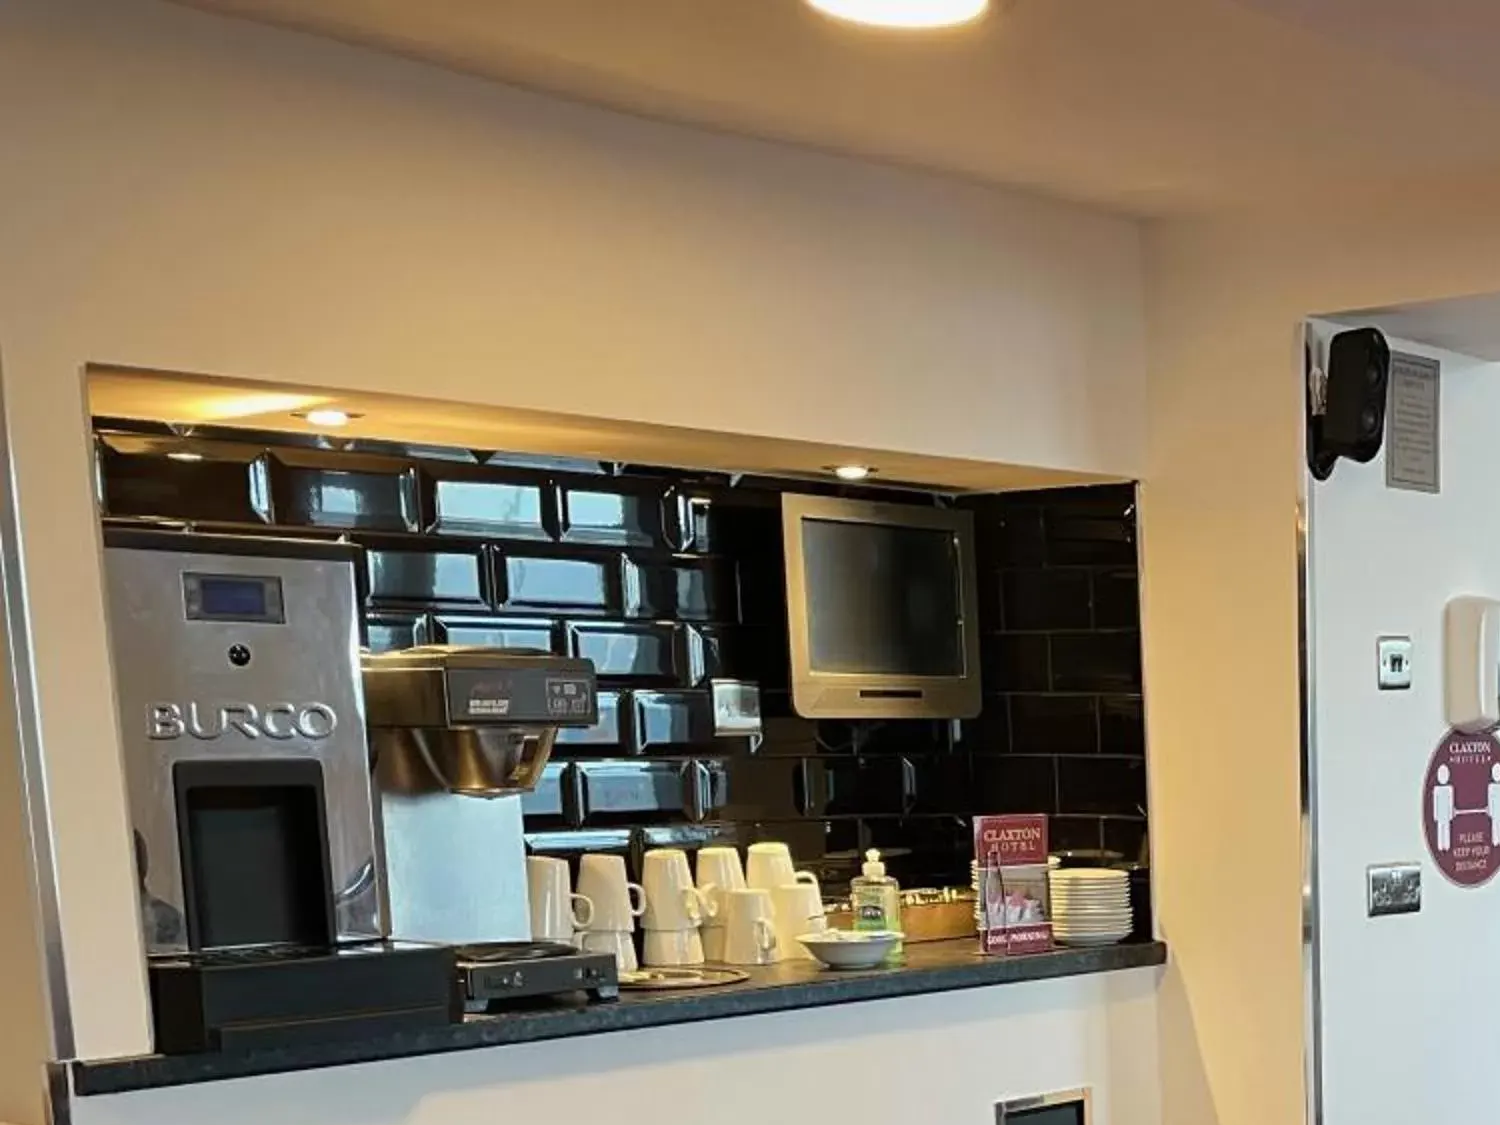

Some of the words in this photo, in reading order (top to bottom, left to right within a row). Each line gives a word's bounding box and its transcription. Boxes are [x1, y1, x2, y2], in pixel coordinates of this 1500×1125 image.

[146, 701, 338, 740] BURCO
[1449, 742, 1491, 754] CLAXTON
[983, 828, 1041, 841] CLAXTON
[991, 842, 1036, 852] HOTEL
